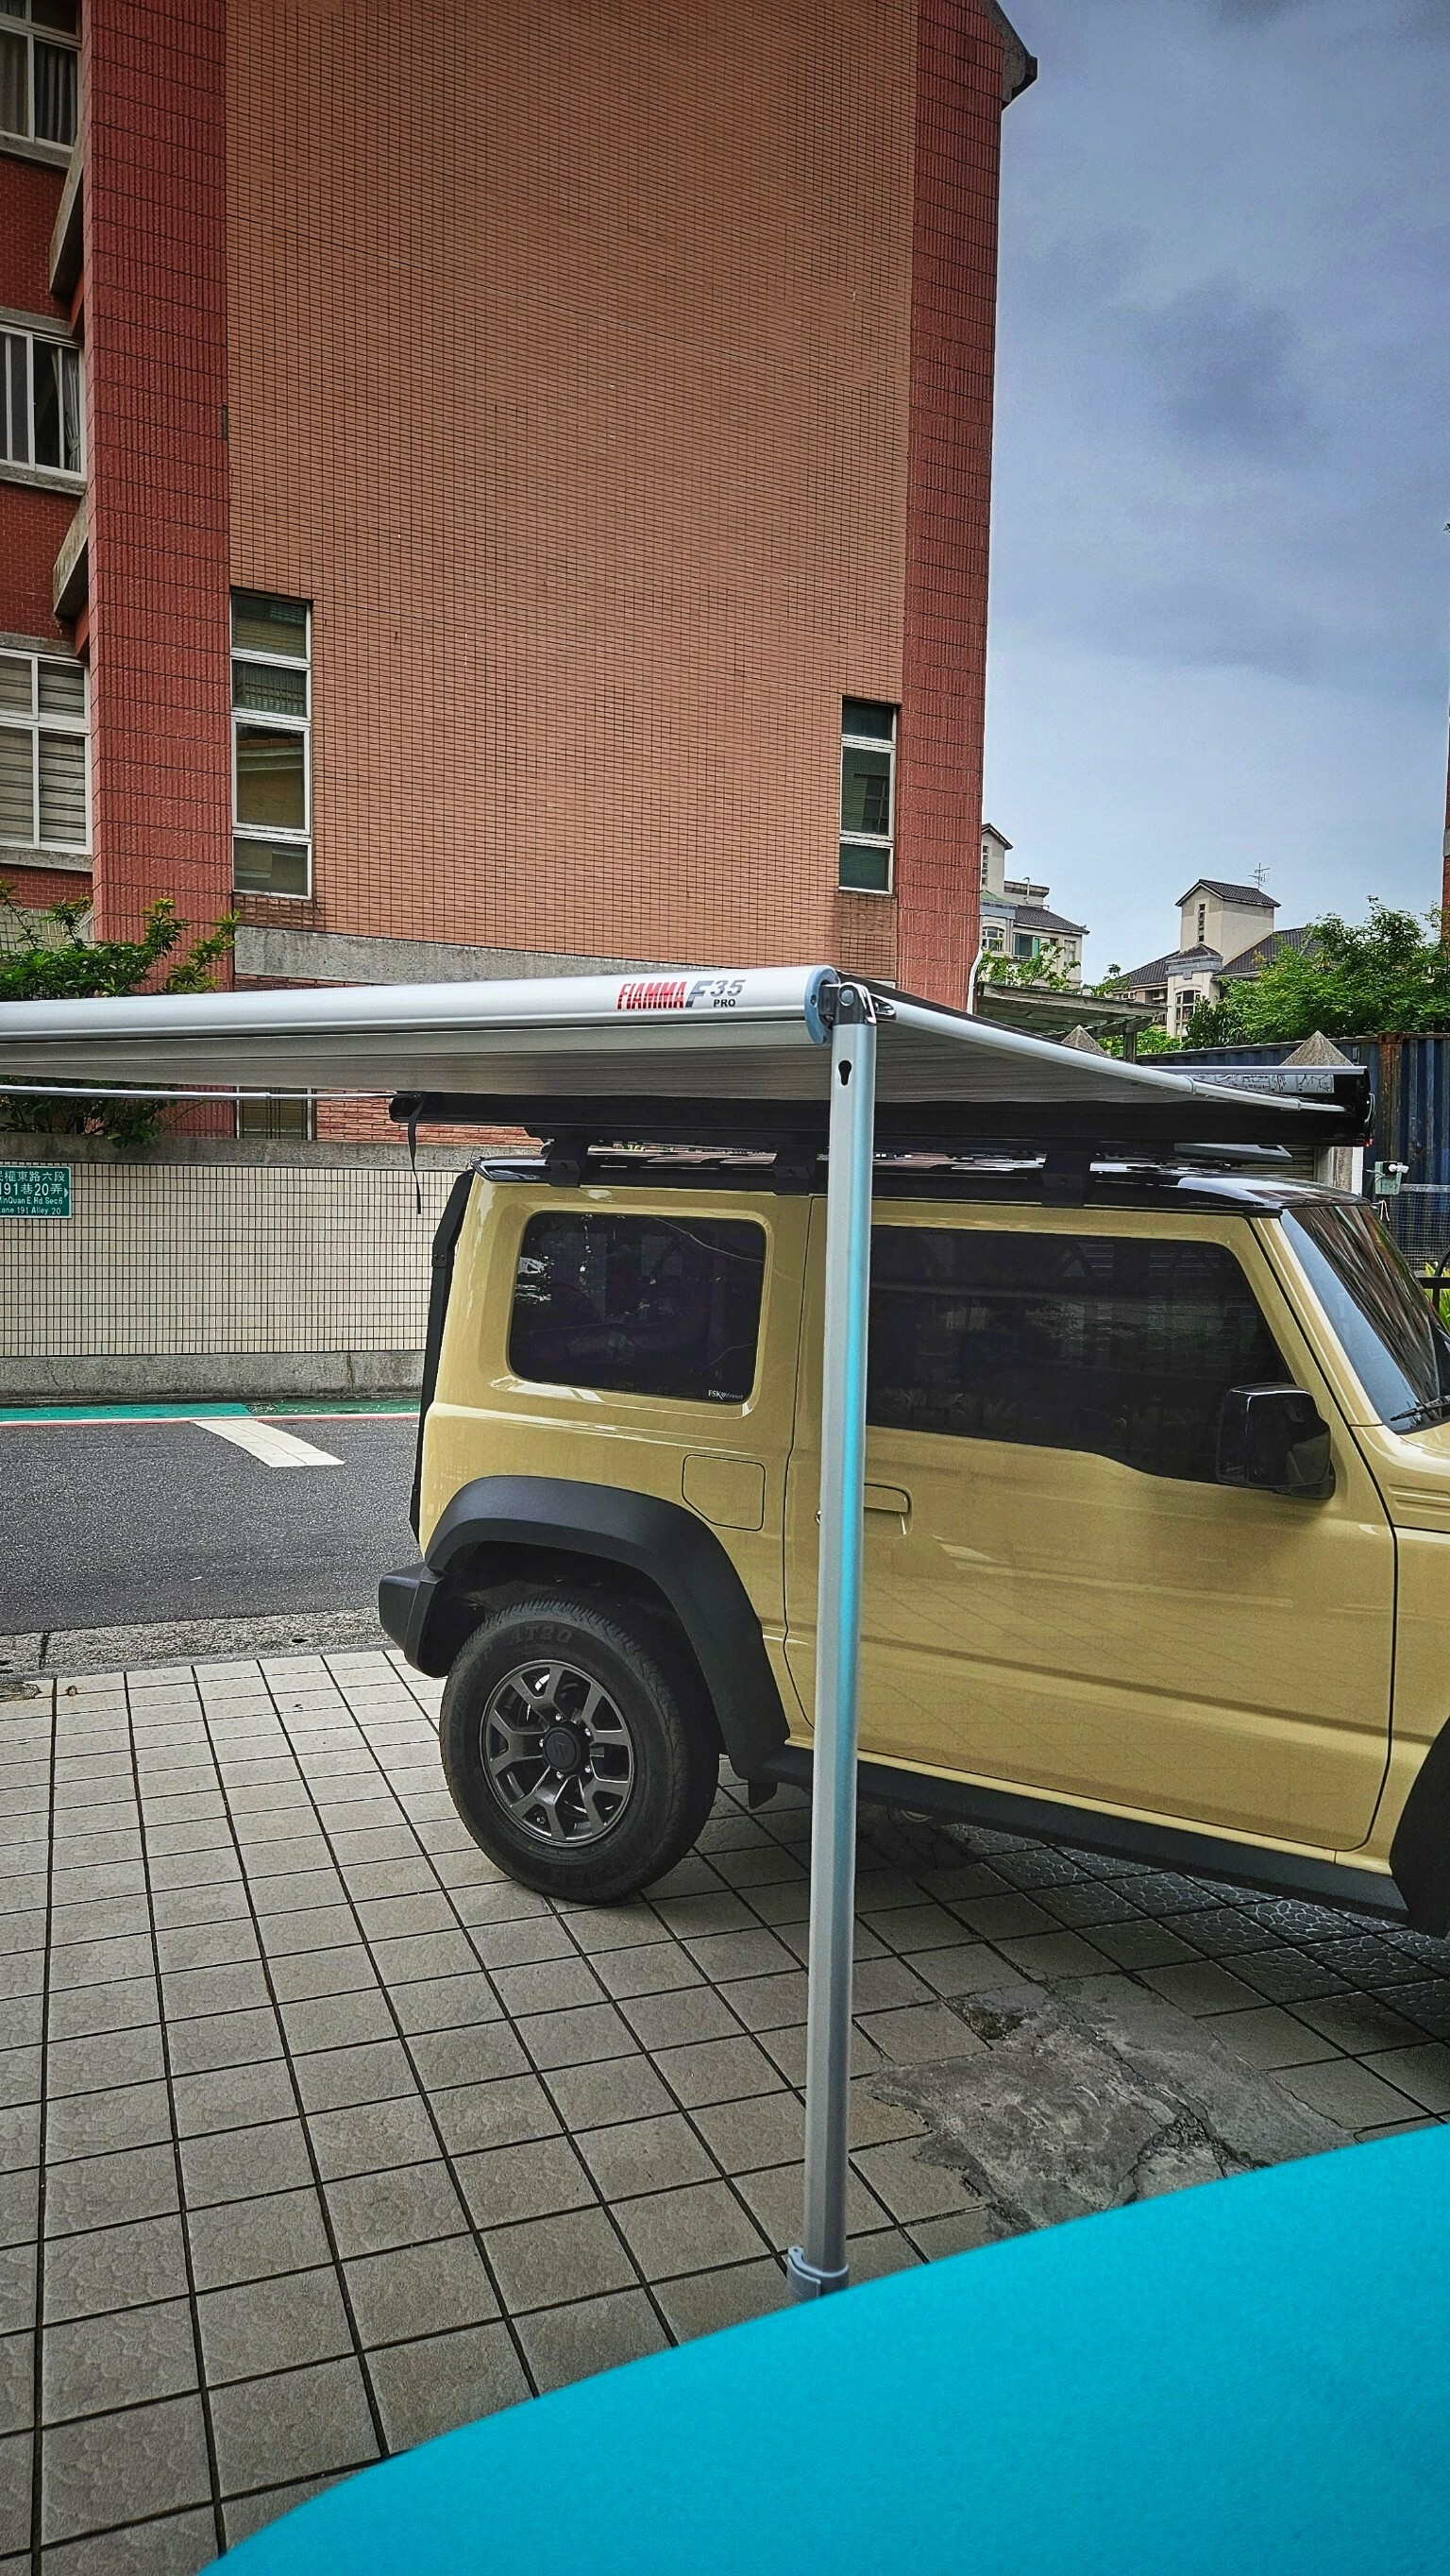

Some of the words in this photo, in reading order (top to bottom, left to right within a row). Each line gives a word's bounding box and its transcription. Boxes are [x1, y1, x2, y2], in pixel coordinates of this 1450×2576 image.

[617, 981, 688, 1010] FIAMMA
[713, 998, 736, 1008] PRO
[0, 1195, 25, 1205] inQuan
[17, 1206, 28, 1214] 191
[31, 1206, 48, 1215] Alley
[51, 1207, 61, 1215] 20
[708, 1389, 724, 1400] FSK
